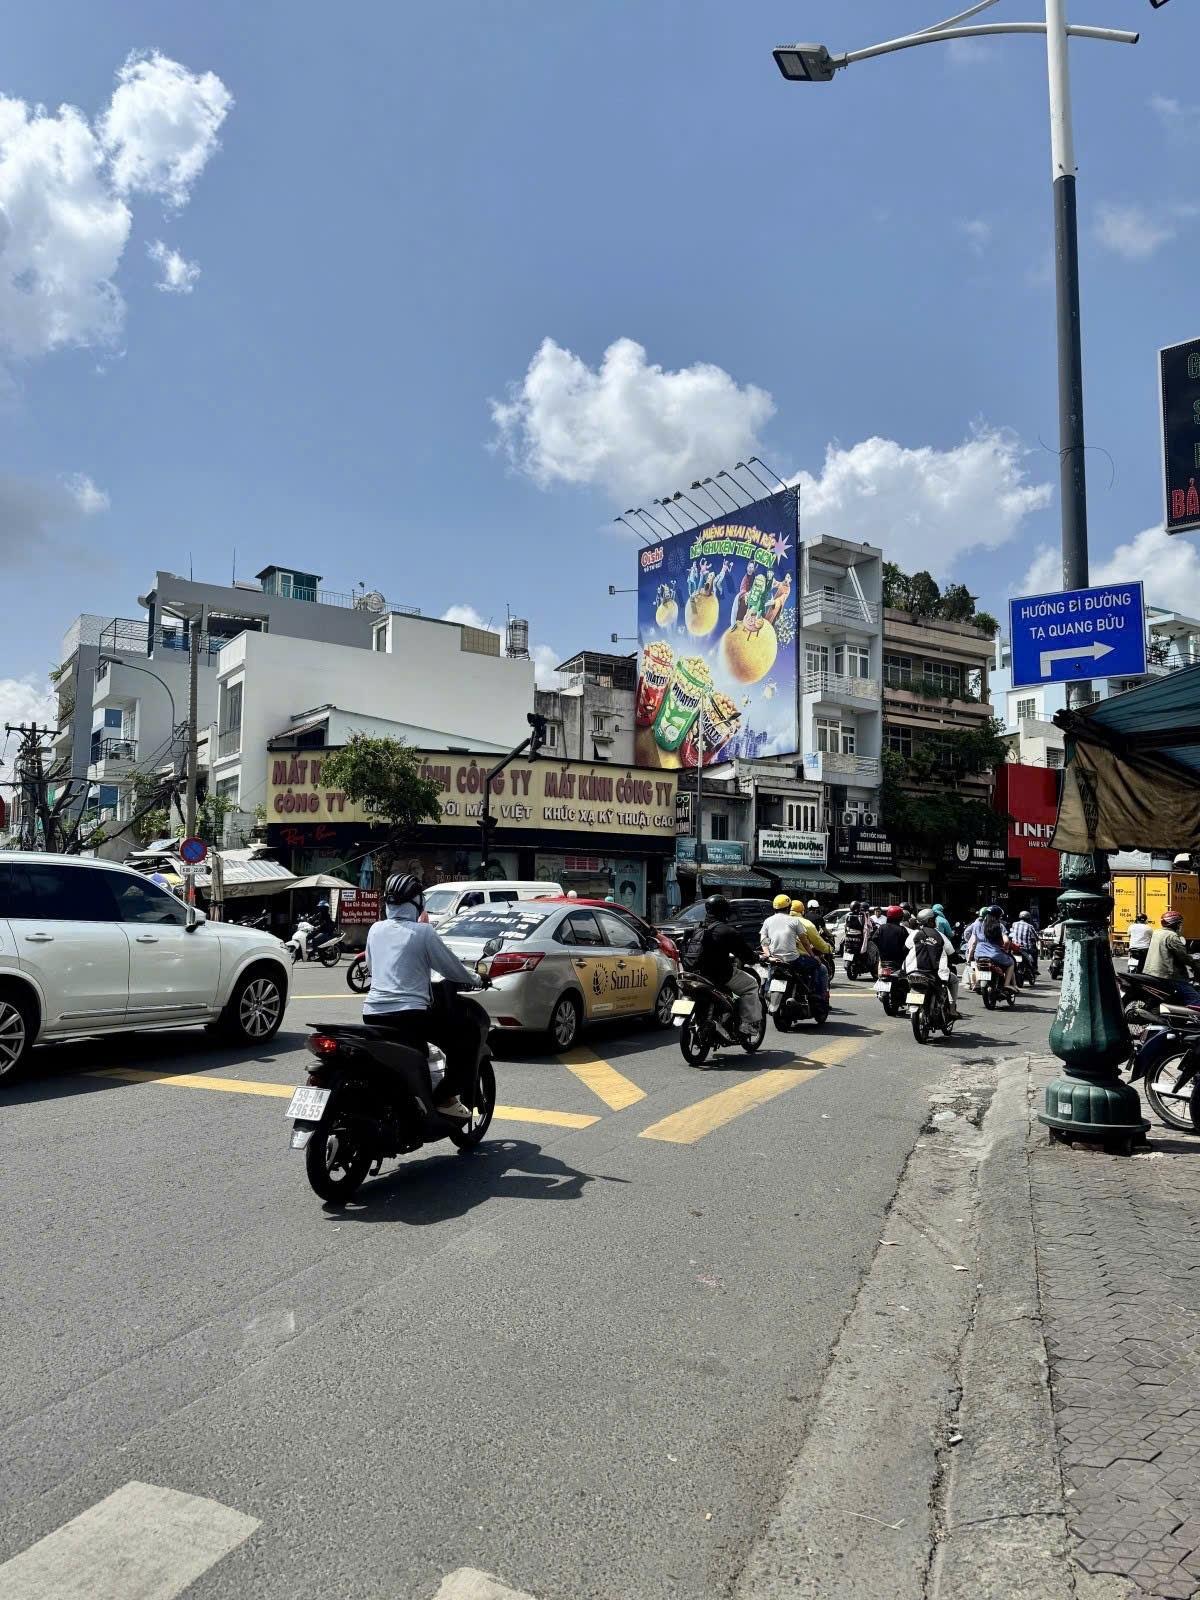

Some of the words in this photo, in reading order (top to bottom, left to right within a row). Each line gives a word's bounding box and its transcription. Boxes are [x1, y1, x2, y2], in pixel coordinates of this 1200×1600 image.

[725, 525, 746, 539] NHAI
[641, 546, 664, 567] Oishi
[702, 537, 736, 557] CHUYỆN
[736, 539, 757, 558] TẾT
[1021, 600, 1065, 619] HƯỚNG
[1085, 592, 1131, 610] ĐƯỜNG
[1030, 626, 1045, 641] TẠ
[1048, 620, 1093, 637] QUANG
[1097, 613, 1124, 631] BỬU
[272, 752, 308, 785] MẮT
[511, 769, 533, 796] TY
[544, 763, 576, 799] MẮT
[578, 768, 614, 803] KÍNH
[616, 771, 654, 806] CÔNG
[655, 781, 673, 807] TY
[273, 787, 320, 813] CÔNG
[325, 792, 347, 813] TY
[500, 803, 533, 822] VIỆT
[544, 804, 576, 821] KHÚC
[579, 808, 596, 826] XẠ
[598, 808, 615, 824] KỸ
[617, 811, 652, 829] THUẬT
[653, 815, 675, 828] CAO
[762, 838, 787, 850] PHƯỚC
[787, 841, 798, 850] AN
[361, 891, 377, 899] Thuê
[610, 970, 630, 990] Sun
[631, 967, 648, 988] Life
